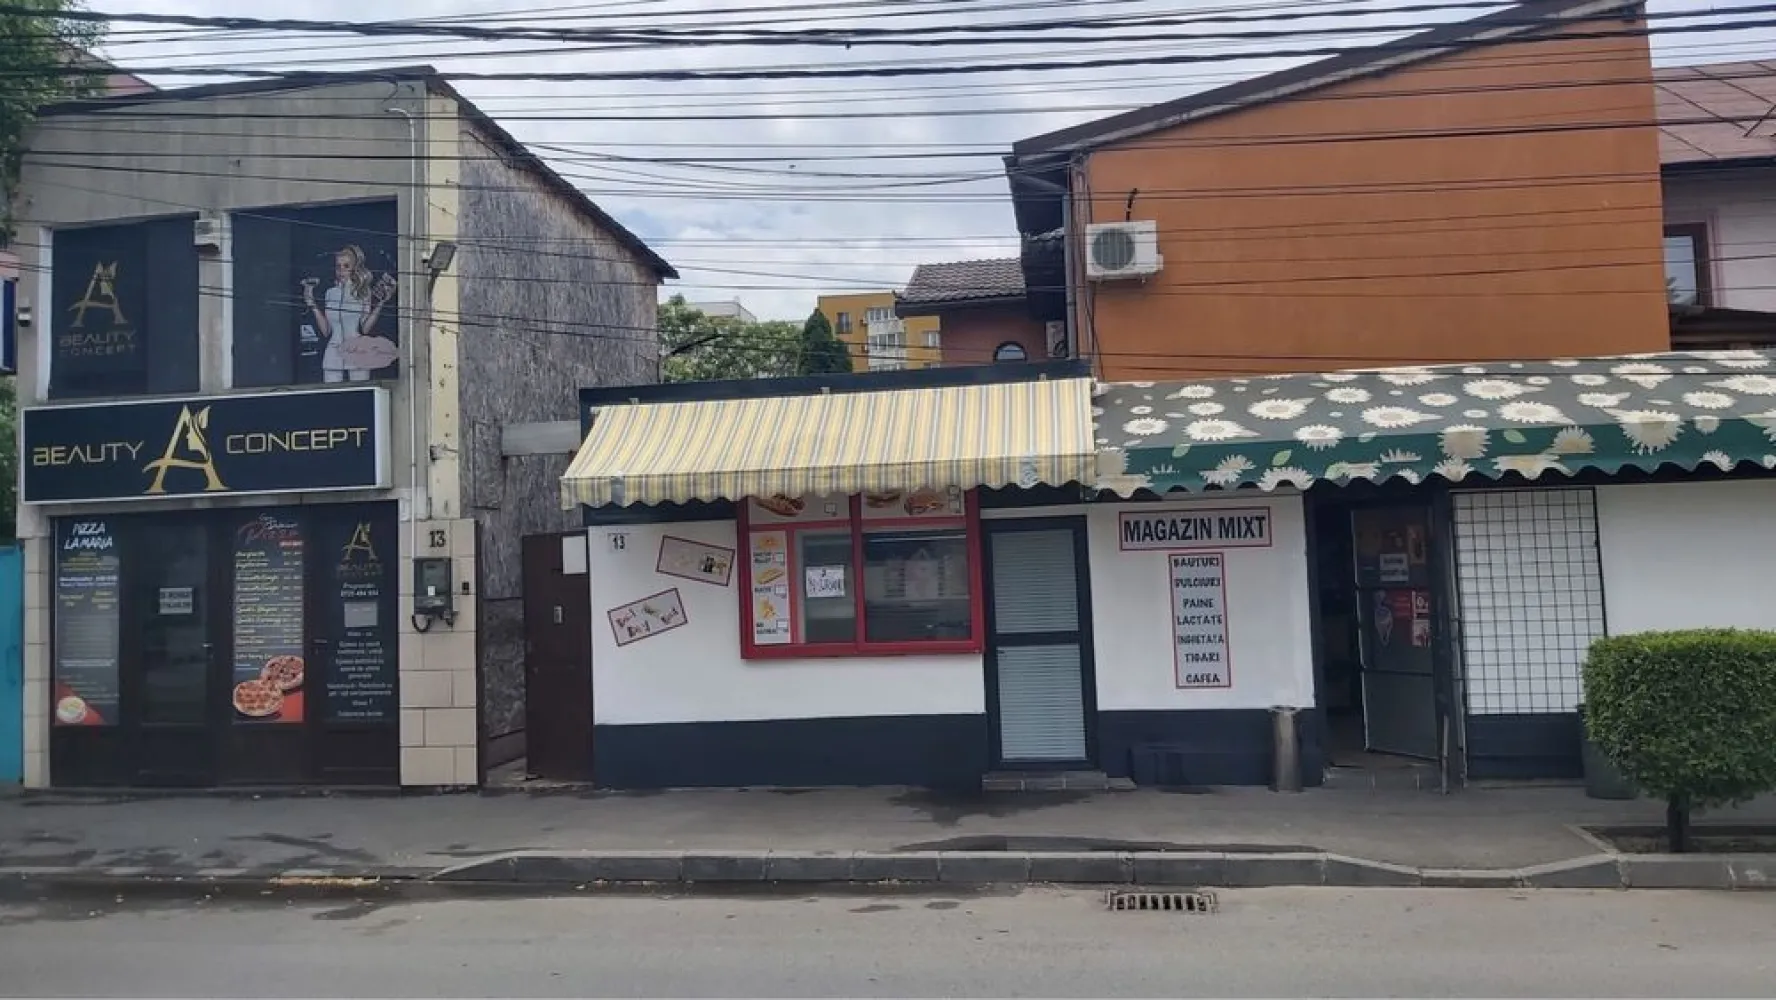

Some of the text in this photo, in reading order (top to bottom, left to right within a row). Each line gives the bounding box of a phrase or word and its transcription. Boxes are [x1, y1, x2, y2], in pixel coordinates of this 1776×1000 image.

[60, 331, 137, 347] BEAUTY
[34, 441, 144, 466] BEAUTY
[226, 427, 367, 454] CONCEPT
[73, 522, 106, 535] PIZZA
[1124, 516, 1266, 542] MAGAZIN MIXT
[64, 539, 80, 550] LA
[429, 530, 446, 548] 13
[613, 534, 625, 550] 13
[1174, 557, 1219, 567] BAUTURI
[1174, 577, 1221, 588] DULCIURI
[1183, 598, 1214, 608] PAINE
[1177, 615, 1222, 626] LACTATE
[1177, 634, 1224, 645] INGHETATA
[1184, 652, 1220, 663] TIGARI
[1186, 673, 1220, 684] CAFEA
